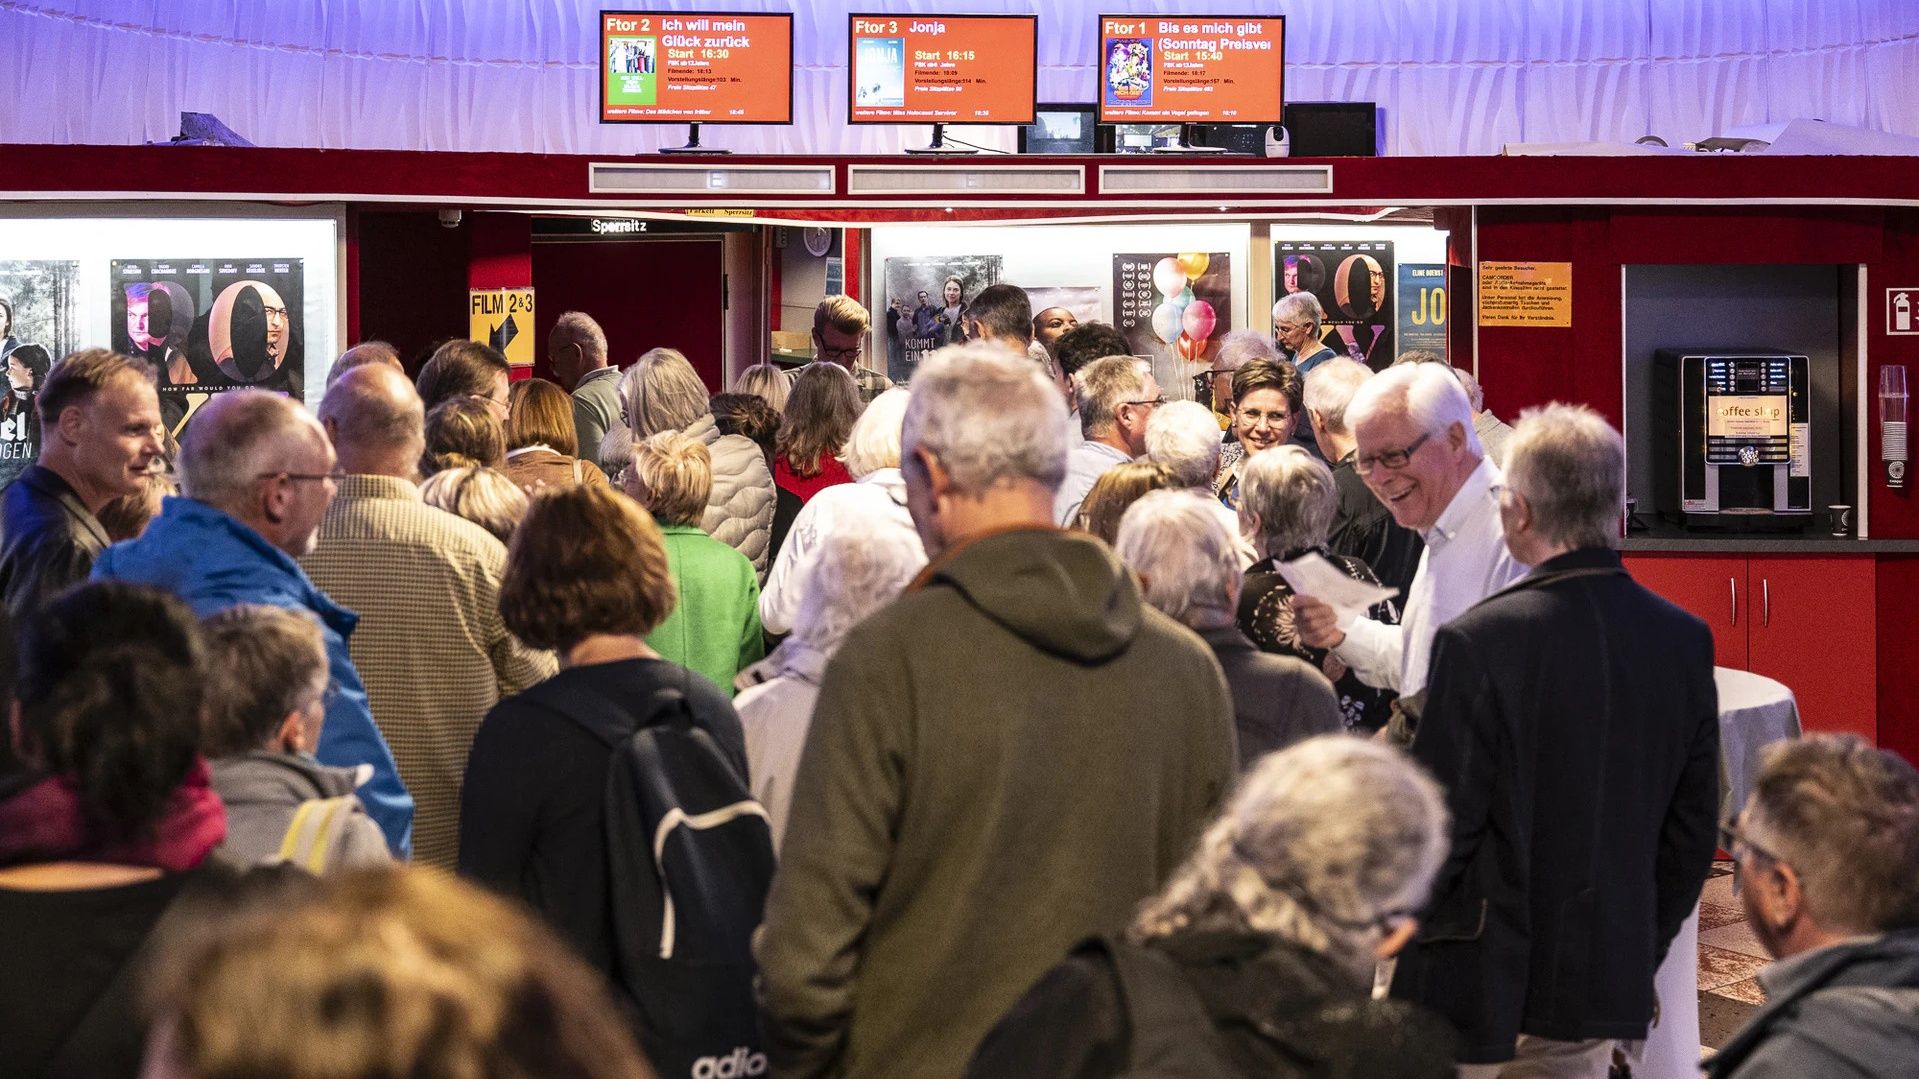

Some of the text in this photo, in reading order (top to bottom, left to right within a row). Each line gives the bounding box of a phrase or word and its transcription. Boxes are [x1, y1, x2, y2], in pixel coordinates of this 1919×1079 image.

[606, 18, 650, 31] Ftor 2
[662, 19, 745, 31] Ich will mein
[856, 21, 898, 33] Ftor 3
[909, 21, 945, 36] Jonja
[1105, 22, 1146, 34] Ftor 1
[1158, 22, 1262, 36] Bis es mich gibt
[662, 34, 750, 47] Glück zurück
[1158, 38, 1216, 52] (Sonntag
[668, 48, 729, 58] Start 16:30
[914, 50, 975, 60] Start 16:15
[1164, 51, 1223, 60] Start 15:40
[592, 220, 647, 234] Sperrsitz
[472, 294, 503, 315] FILM
[905, 338, 935, 349] KOMMT
[906, 351, 920, 362] EIN
[1717, 407, 1780, 418] offee sp
[0, 442, 32, 459] GEN
